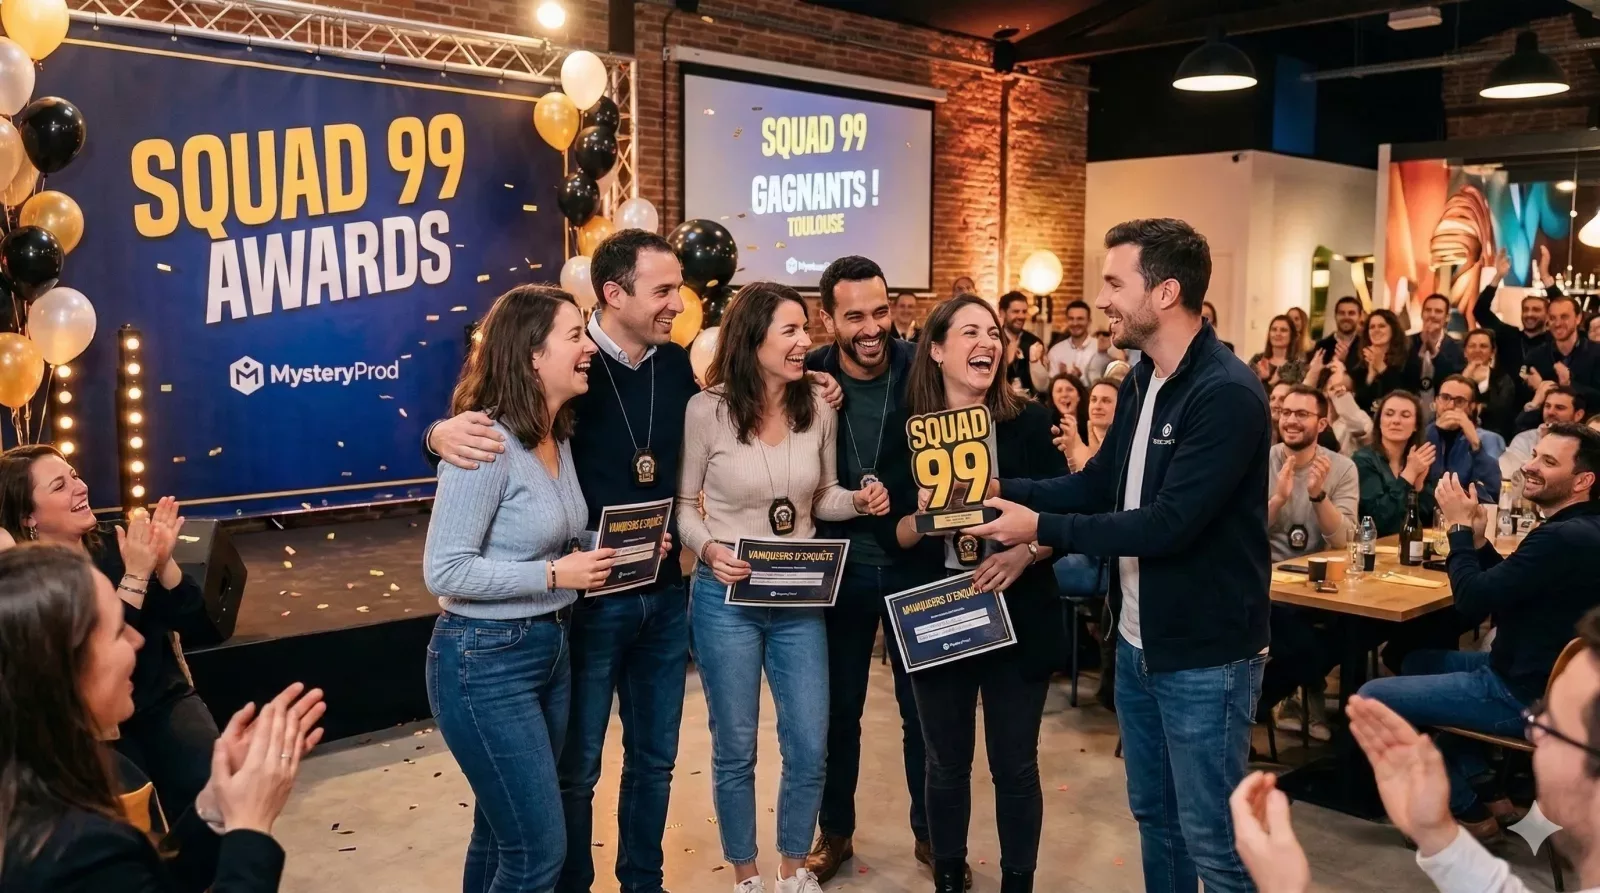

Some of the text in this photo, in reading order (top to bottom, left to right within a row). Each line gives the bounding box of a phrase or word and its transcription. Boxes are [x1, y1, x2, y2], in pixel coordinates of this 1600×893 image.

[762, 113, 867, 159] SQUAD 99
[131, 113, 466, 238] SQUAD 99
[752, 169, 880, 215] GAGNANTS !
[787, 213, 845, 237] TOULOUSE
[206, 209, 452, 325] AWARDS
[270, 358, 400, 389] MysteryProd
[910, 408, 987, 449] SQUAD
[916, 441, 989, 508] 99
